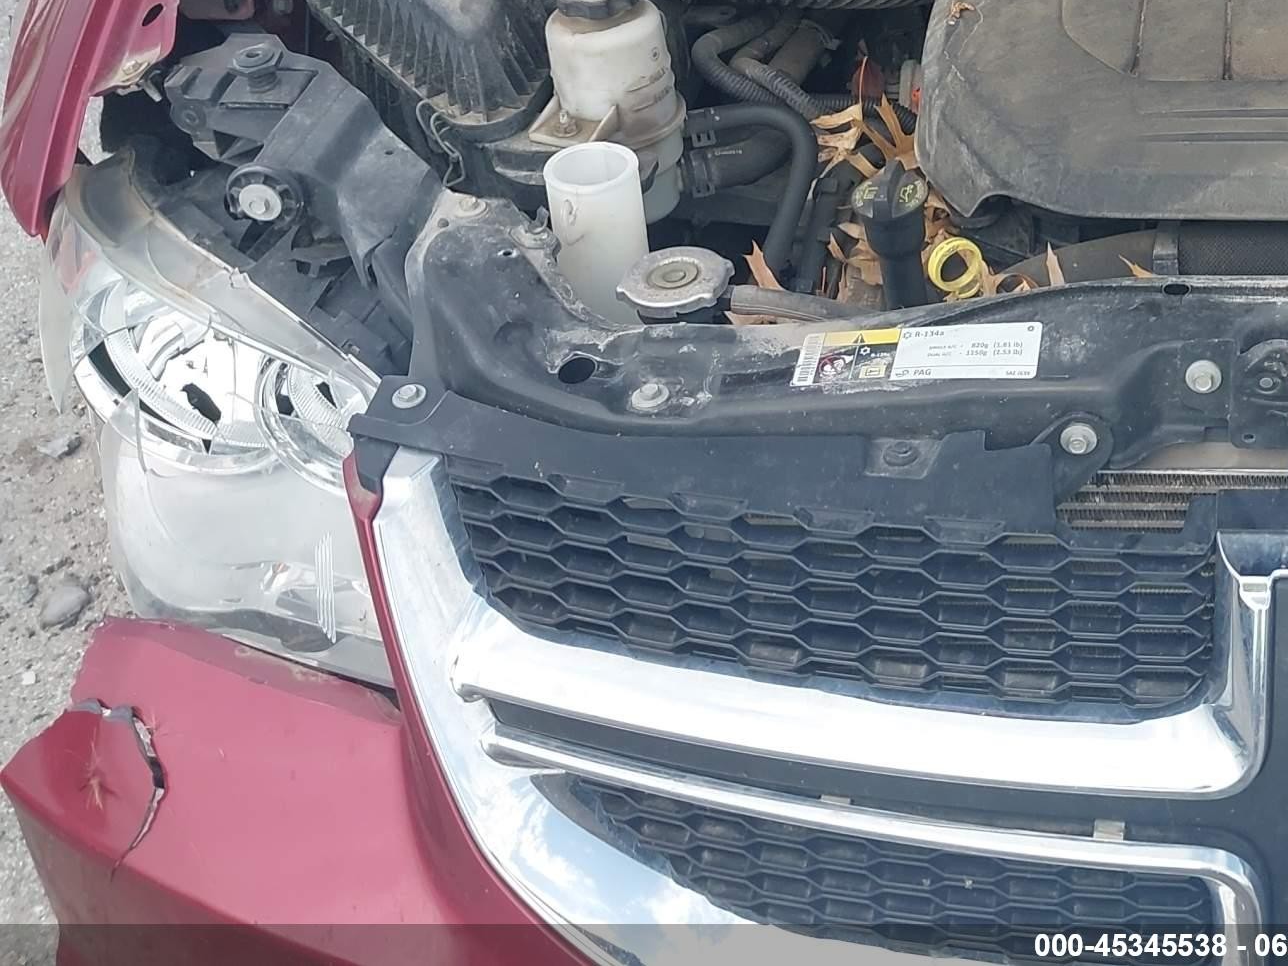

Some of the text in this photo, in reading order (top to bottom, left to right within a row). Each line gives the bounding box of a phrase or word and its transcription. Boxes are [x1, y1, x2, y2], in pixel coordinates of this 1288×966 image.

[914, 330, 945, 339] R-134a
[971, 341, 989, 350] 820g
[1013, 340, 1023, 349] lb)
[913, 368, 932, 376] PAG
